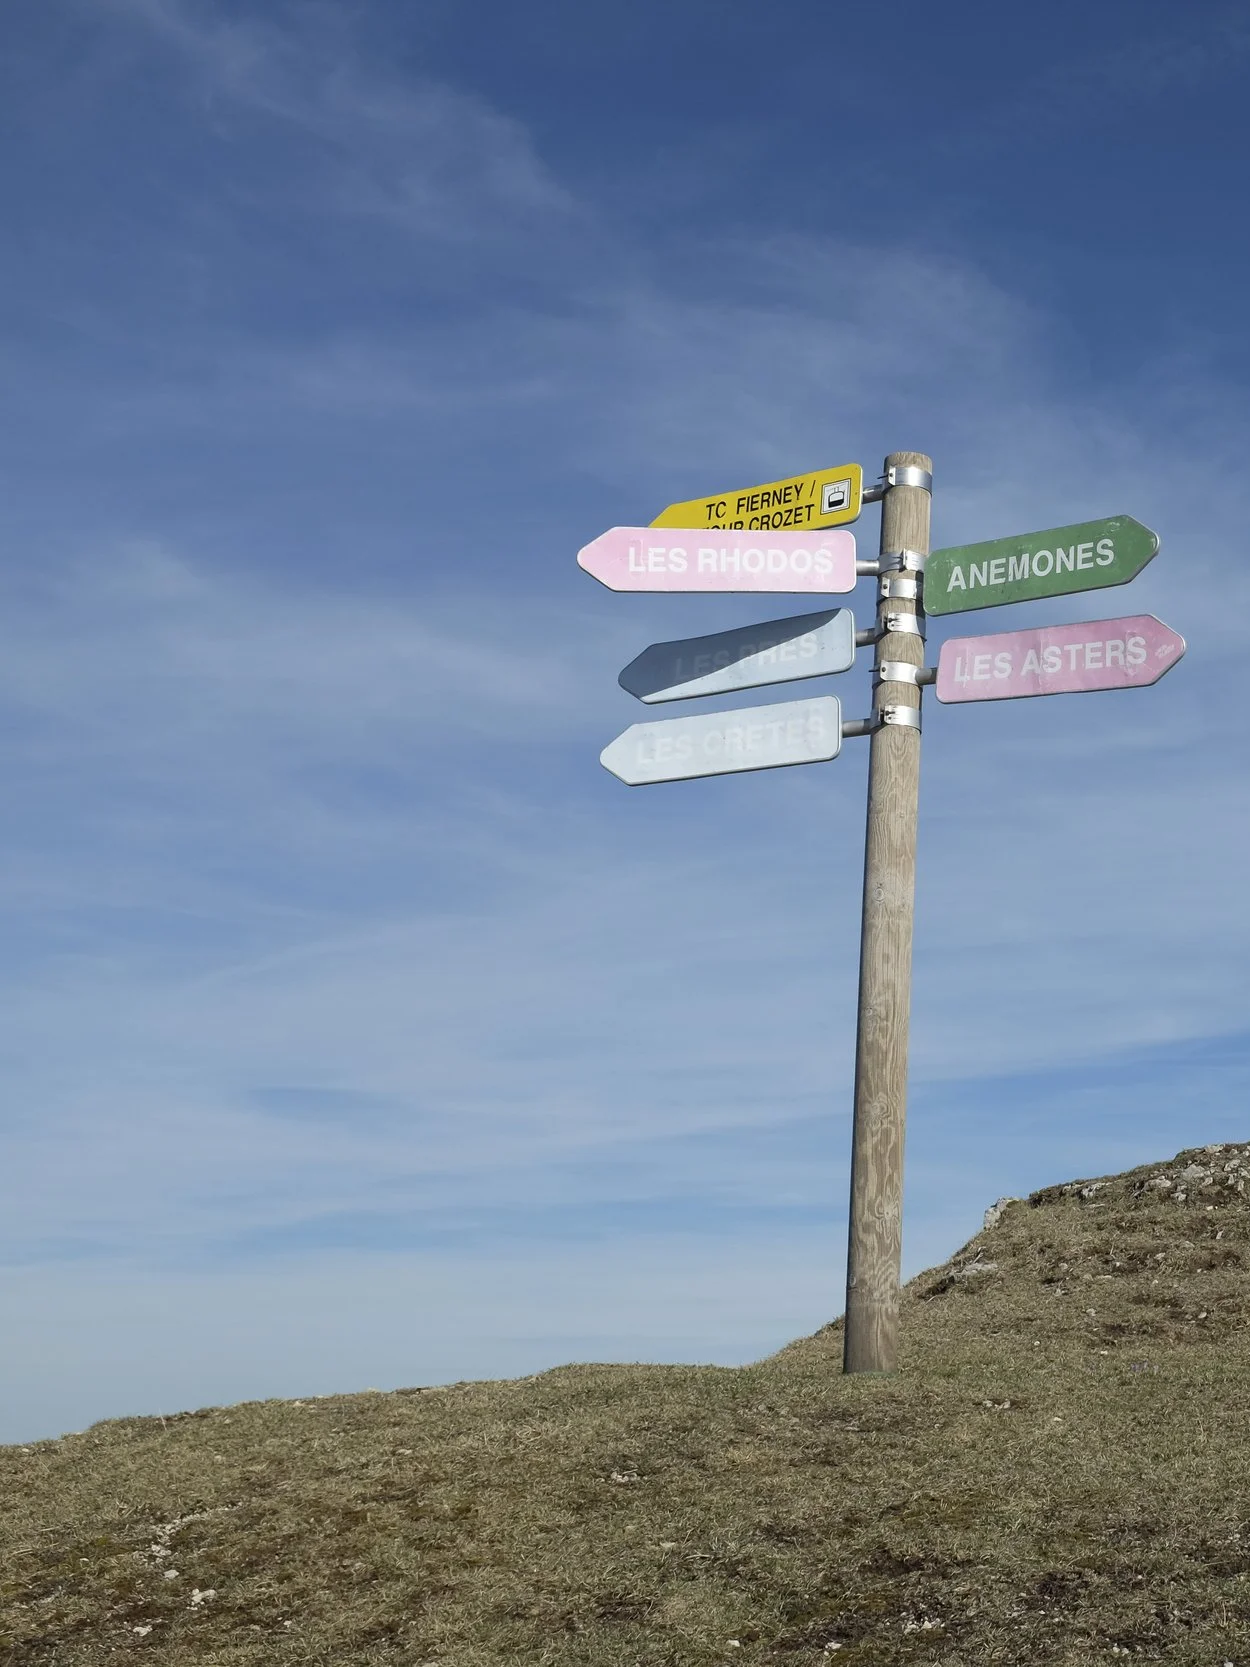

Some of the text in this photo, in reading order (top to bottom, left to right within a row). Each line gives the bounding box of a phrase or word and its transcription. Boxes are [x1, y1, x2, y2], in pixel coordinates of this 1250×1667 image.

[706, 501, 727, 520] TC
[736, 483, 805, 514] FIERNEY
[748, 504, 816, 530] CROZET
[628, 547, 834, 574] LES RHODOS
[946, 538, 1116, 593] ANEMONES
[954, 636, 1148, 683] LES ASTERS
[635, 715, 827, 764] LES CRETES
